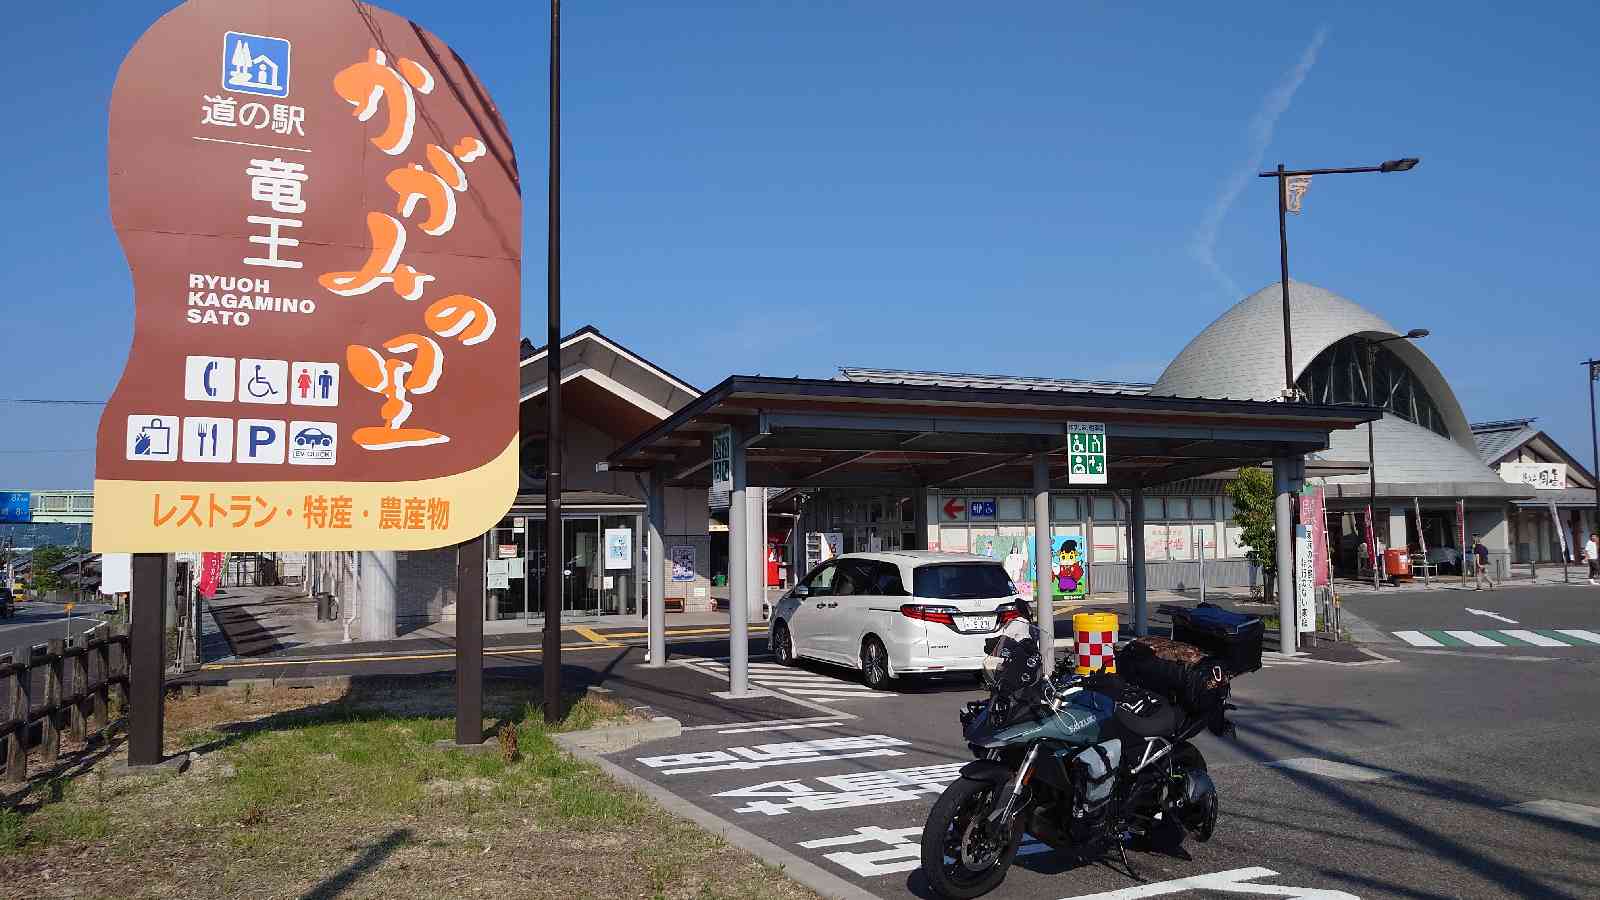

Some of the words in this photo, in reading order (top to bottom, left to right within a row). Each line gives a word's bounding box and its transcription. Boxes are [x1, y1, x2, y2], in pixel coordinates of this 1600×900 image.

[201, 94, 306, 136] 道の駅
[244, 158, 308, 269] 竜王
[318, 47, 497, 451] かがみの里
[189, 273, 271, 294] RYUOH
[187, 309, 251, 328] SATO
[188, 291, 316, 315] KAGAMINO
[250, 426, 276, 457] P
[152, 493, 451, 531] レストラン・特産・農産物
